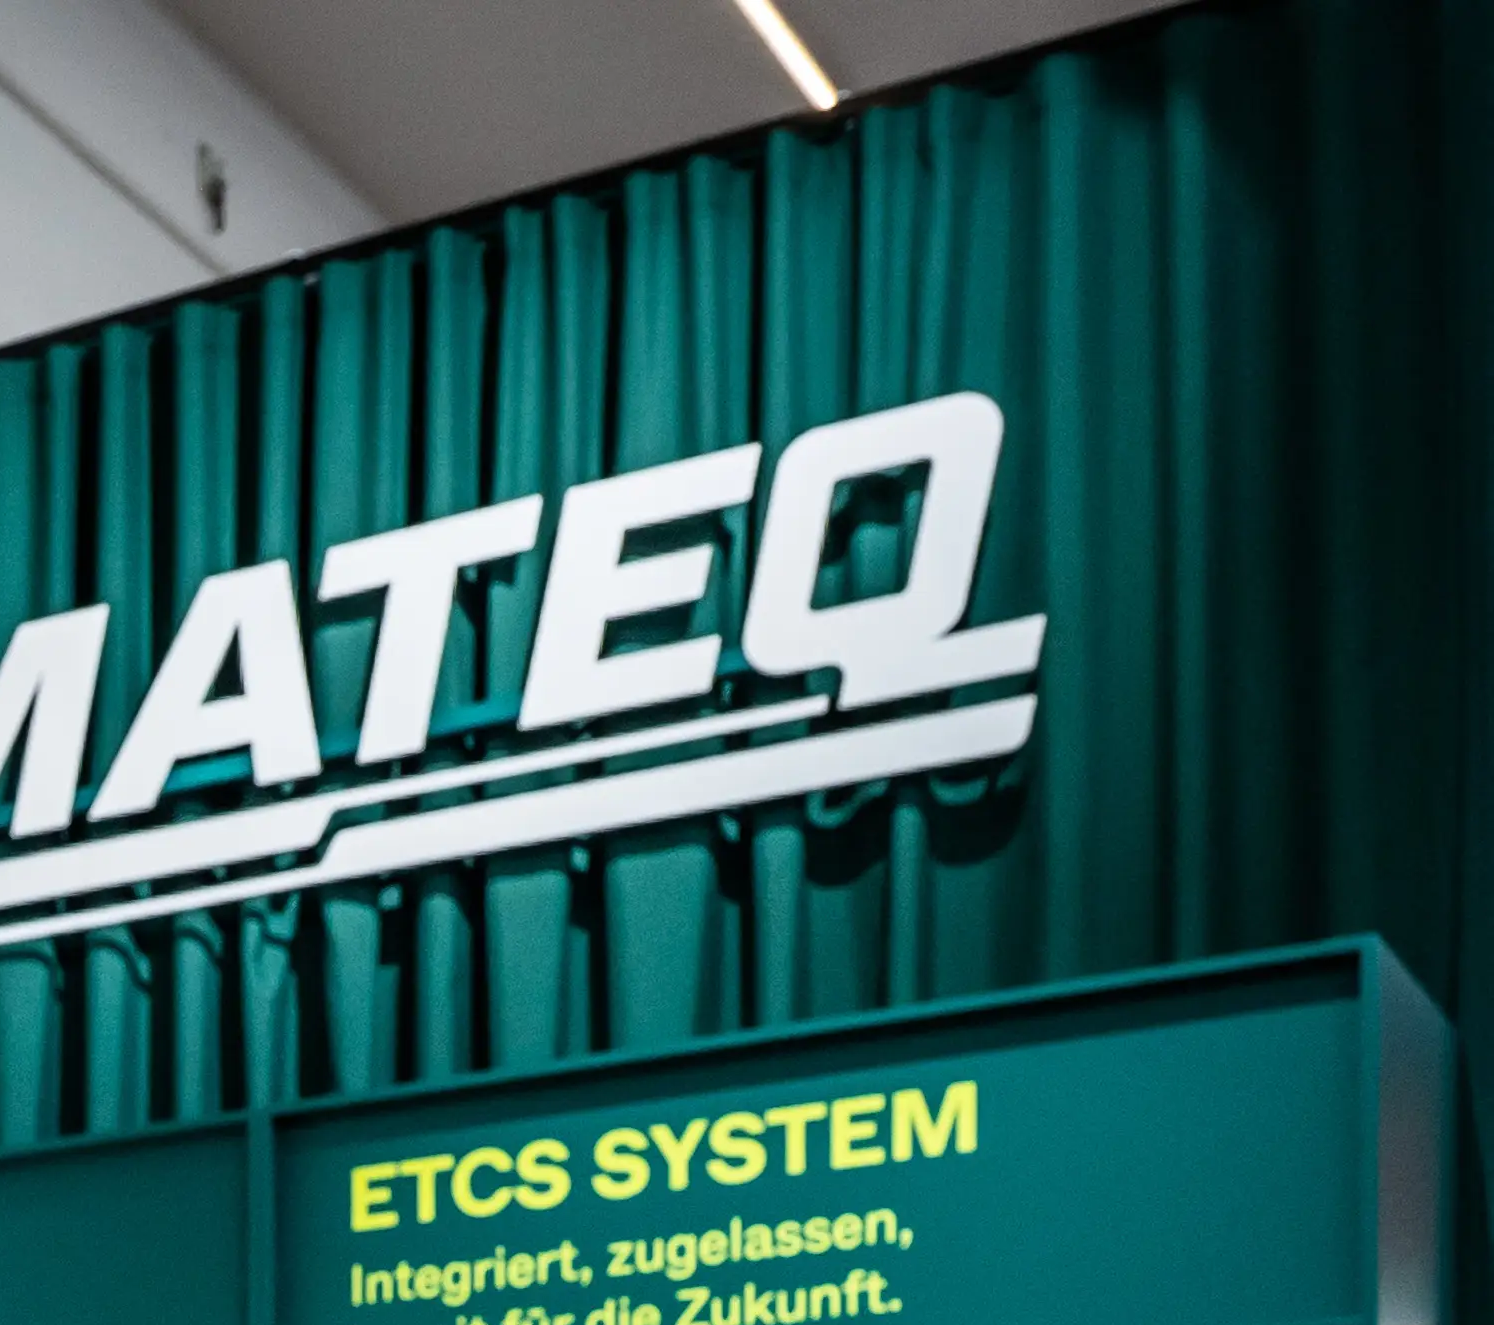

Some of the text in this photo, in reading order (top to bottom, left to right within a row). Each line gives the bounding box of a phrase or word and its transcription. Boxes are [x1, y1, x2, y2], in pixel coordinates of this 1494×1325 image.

[350, 1080, 979, 1232] ETCS SYSTEM
[350, 1208, 913, 1307] Integriert, zugelassen,
